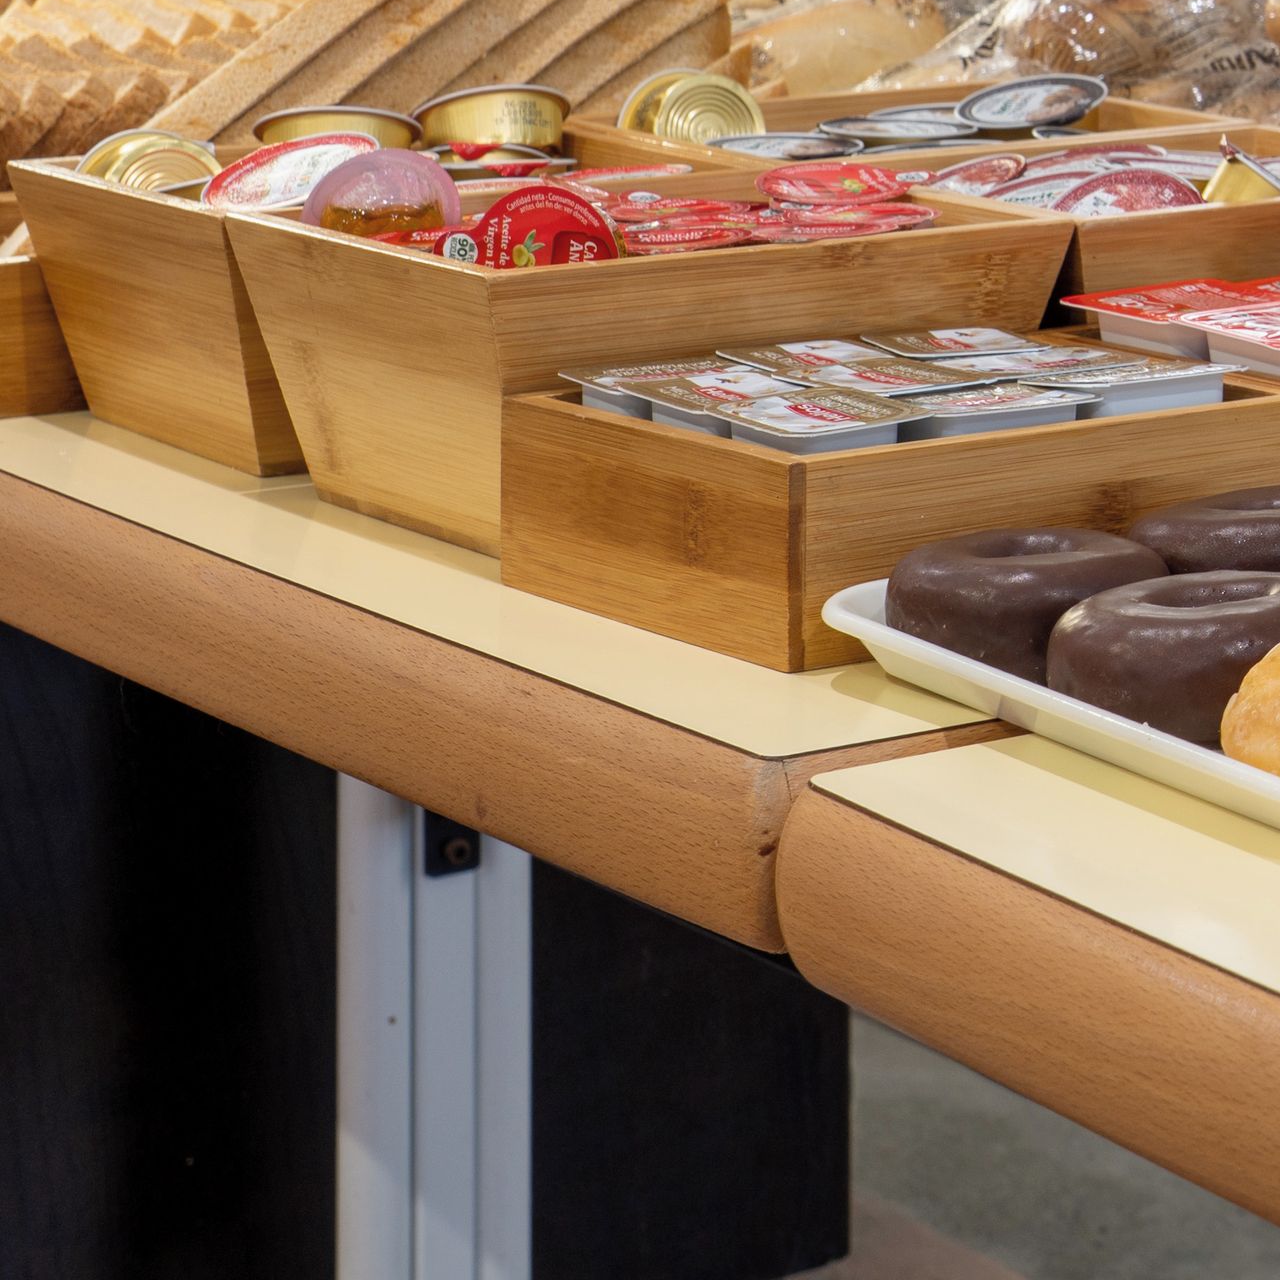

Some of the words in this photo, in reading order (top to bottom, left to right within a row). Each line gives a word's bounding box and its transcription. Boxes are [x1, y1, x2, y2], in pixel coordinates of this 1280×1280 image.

[506, 194, 531, 211] Cantidad
[531, 194, 545, 202] neta
[548, 193, 575, 207] Consumo
[574, 202, 600, 228] preferente
[535, 199, 546, 209] del
[484, 217, 499, 257] Virgen
[502, 214, 513, 249] Aceite
[500, 251, 510, 266] de
